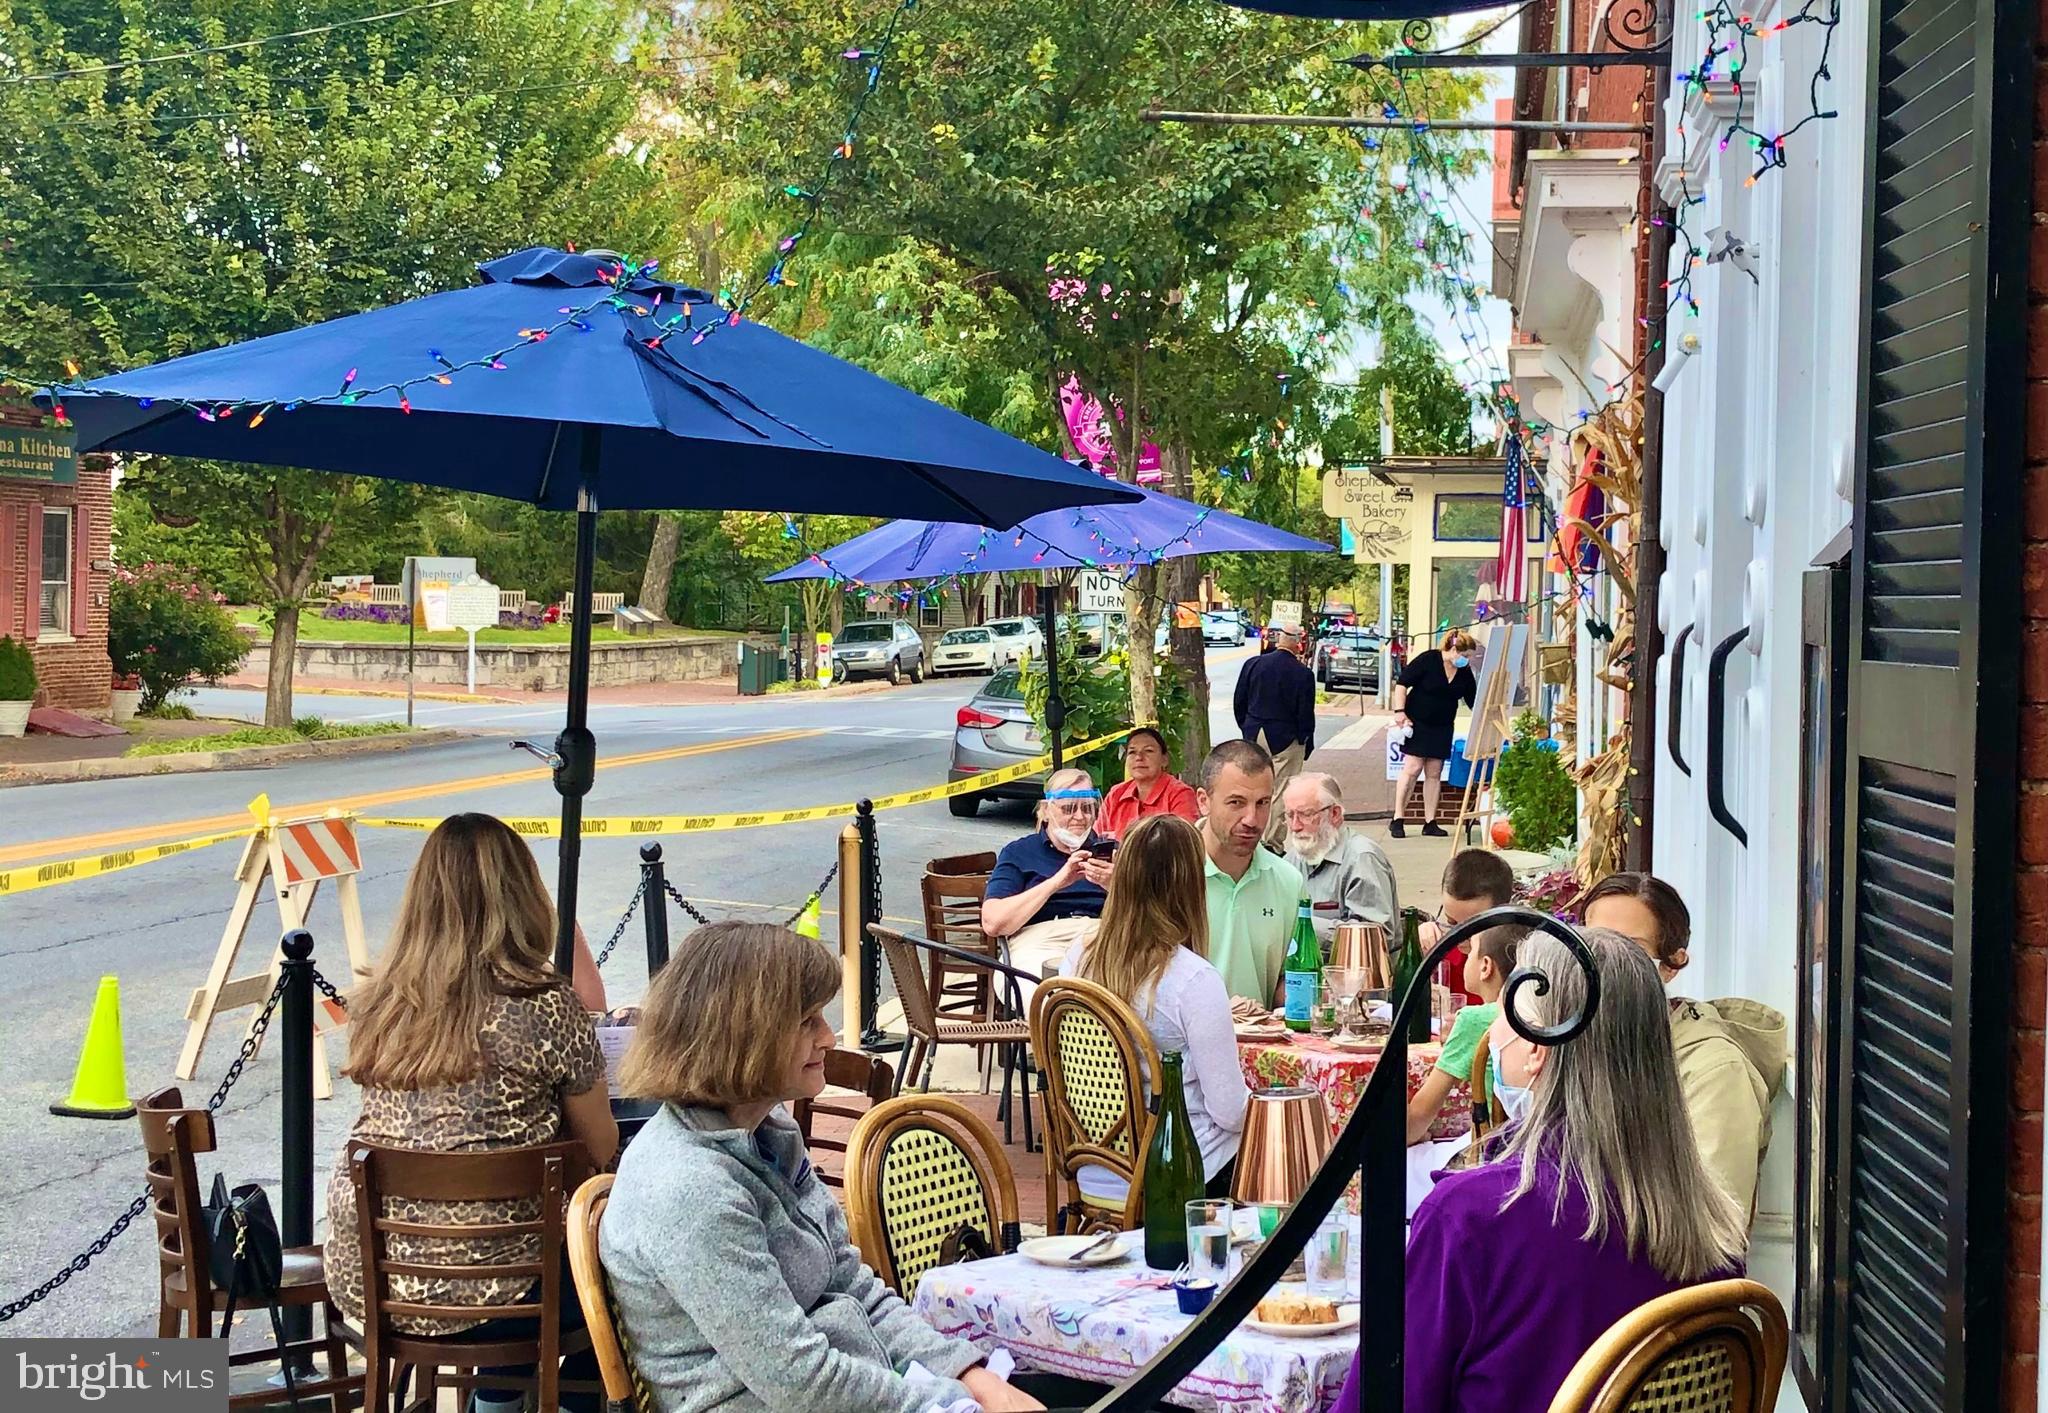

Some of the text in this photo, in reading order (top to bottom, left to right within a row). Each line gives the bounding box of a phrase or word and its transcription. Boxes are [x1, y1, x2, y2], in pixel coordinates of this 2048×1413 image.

[21, 438, 71, 458] Kitchen
[1335, 473, 1388, 491] Shephe
[1344, 489, 1386, 503] Sweet
[1362, 504, 1407, 522] Bakery
[1086, 576, 1110, 591] NO
[1089, 595, 1125, 608] TURN
[1276, 604, 1288, 613] NO
[630, 820, 663, 833] CAUTION
[683, 818, 716, 830] CAUTION
